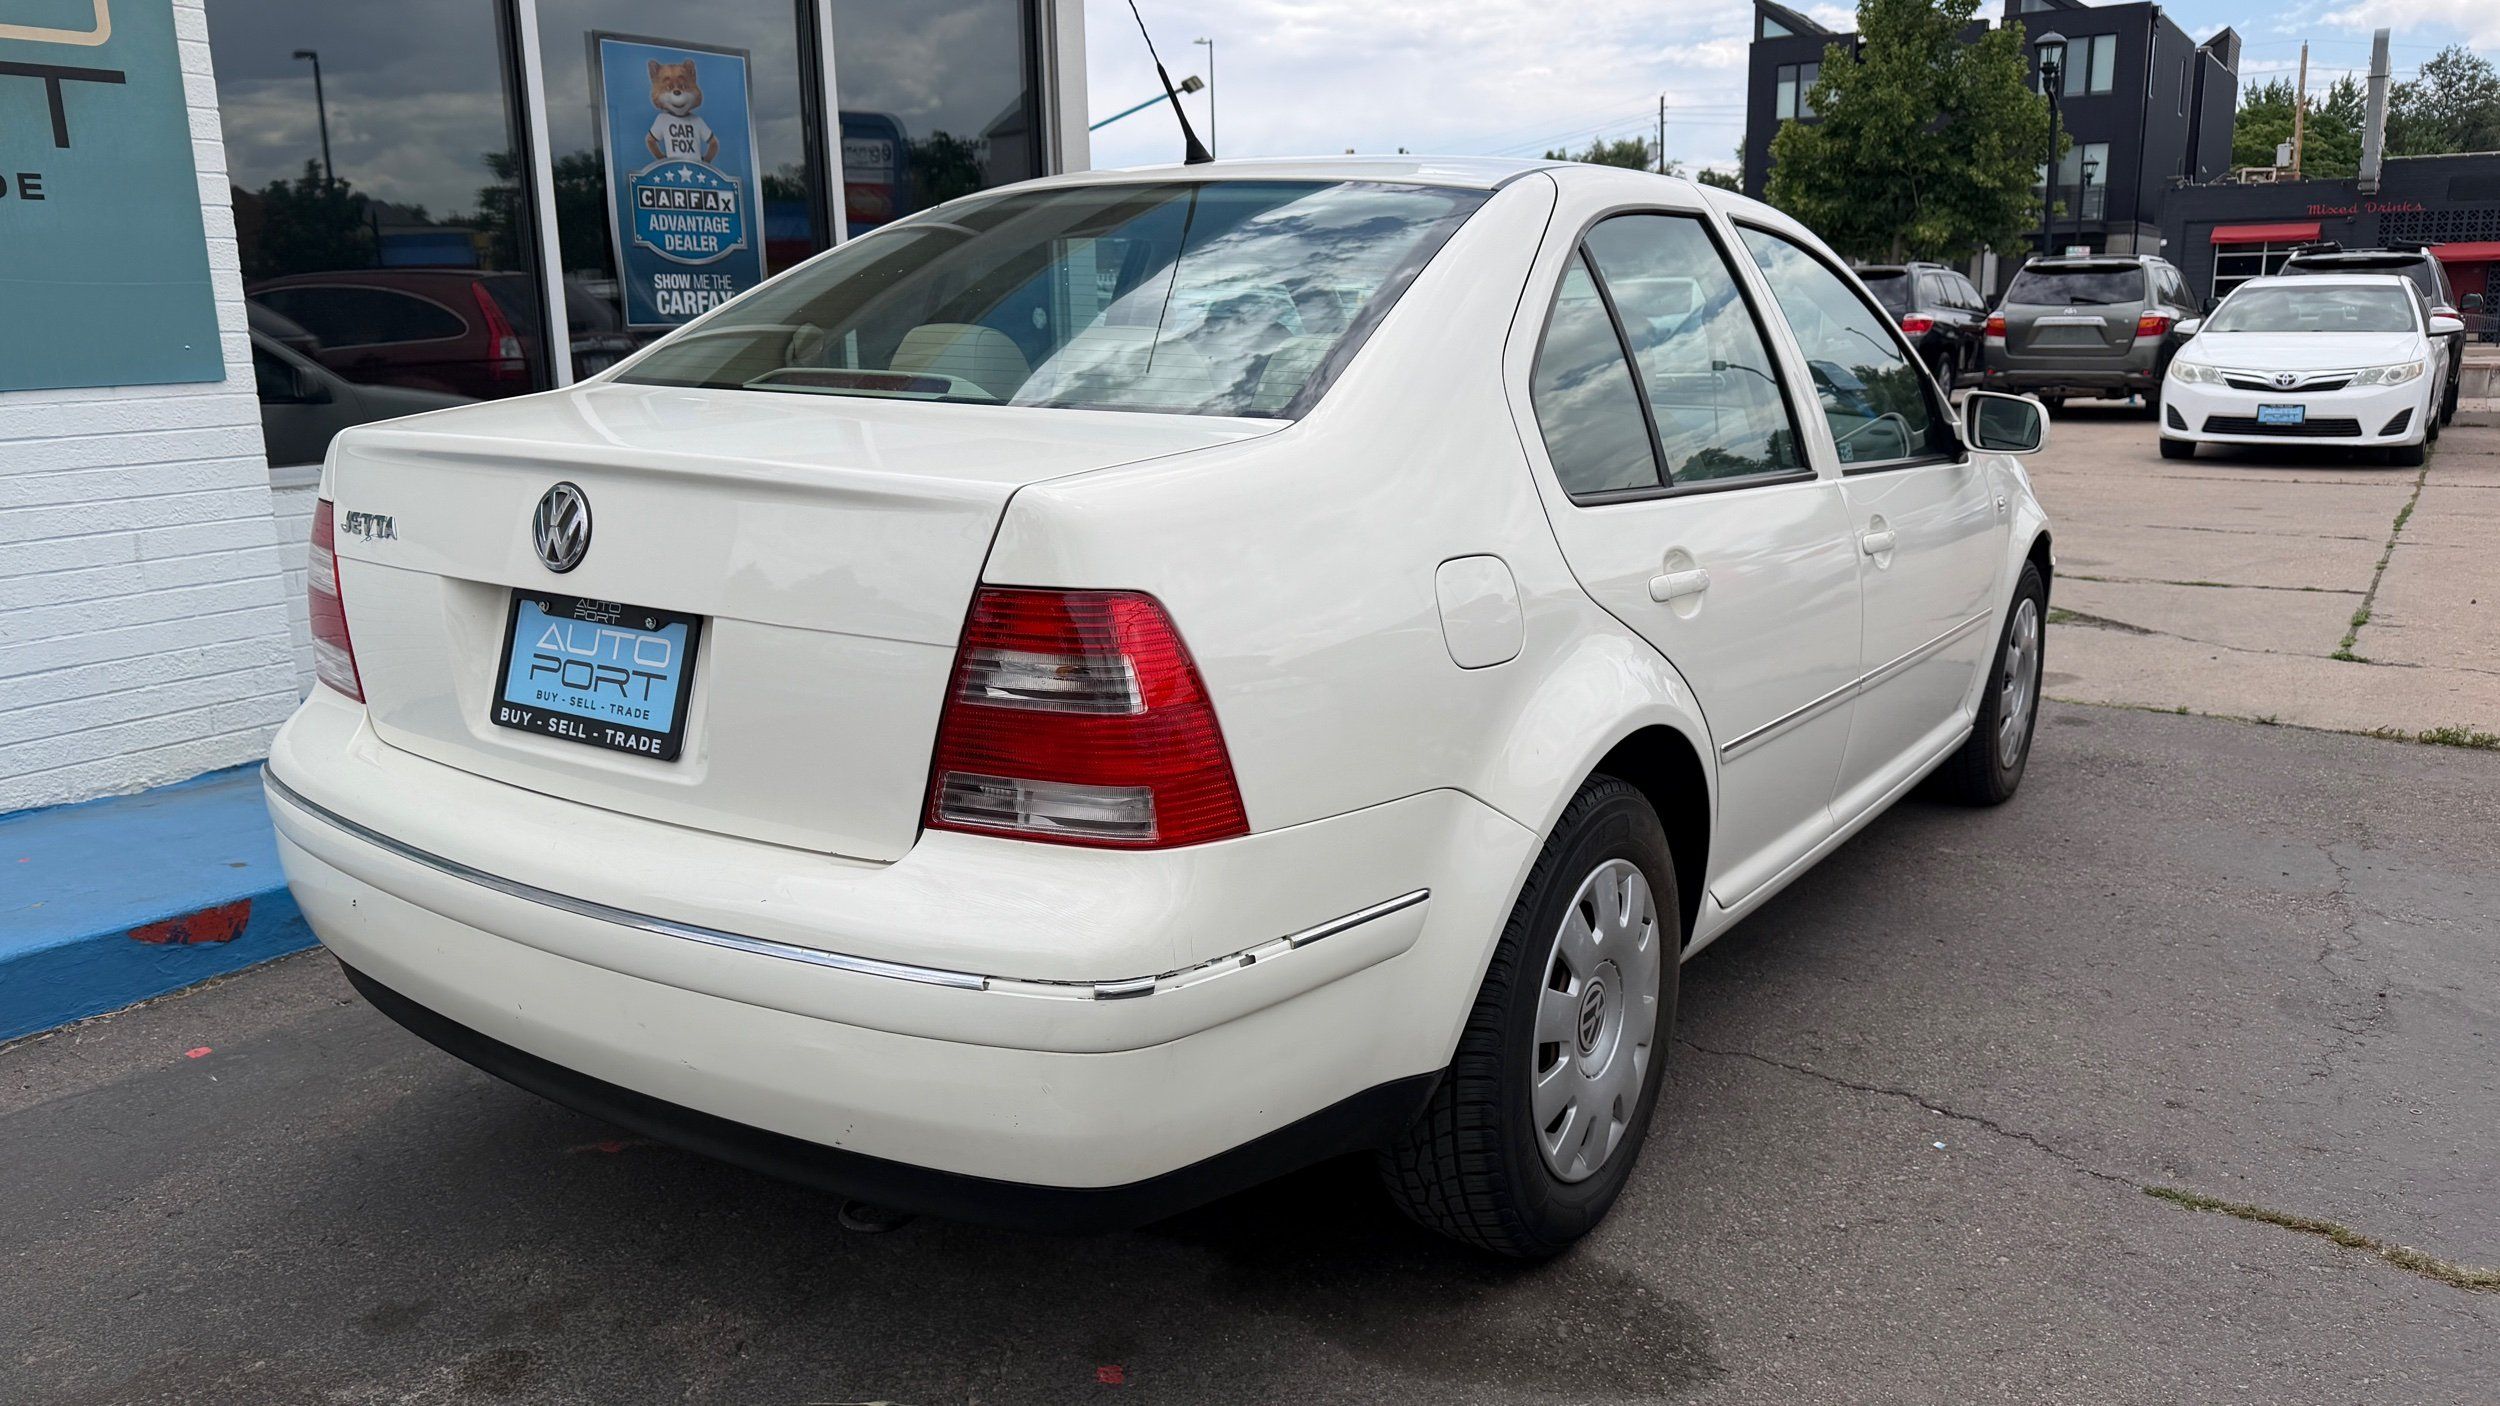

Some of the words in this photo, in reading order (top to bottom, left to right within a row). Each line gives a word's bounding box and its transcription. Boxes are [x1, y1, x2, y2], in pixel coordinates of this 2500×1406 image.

[669, 123, 695, 139] CAR
[671, 138, 696, 153] FOX
[641, 189, 732, 212] CARFAX
[2307, 203, 2358, 215] Mixed
[2365, 201, 2426, 213] Drinks
[649, 213, 731, 233] ADVANTAGE
[664, 233, 719, 252] DEALER
[654, 273, 691, 289] SHOW
[692, 274, 710, 290] ME
[711, 274, 733, 290] THE
[340, 510, 398, 541] JETTA
[576, 598, 622, 614] AUTO
[573, 608, 621, 625] PORT
[536, 622, 672, 668] AUTO
[529, 653, 668, 702] PORT
[536, 690, 559, 702] BUY
[569, 696, 597, 711] SELL
[609, 704, 650, 721] TRADE
[500, 707, 533, 726] BUY
[548, 718, 587, 739] SELL
[605, 729, 662, 754] TRADE
